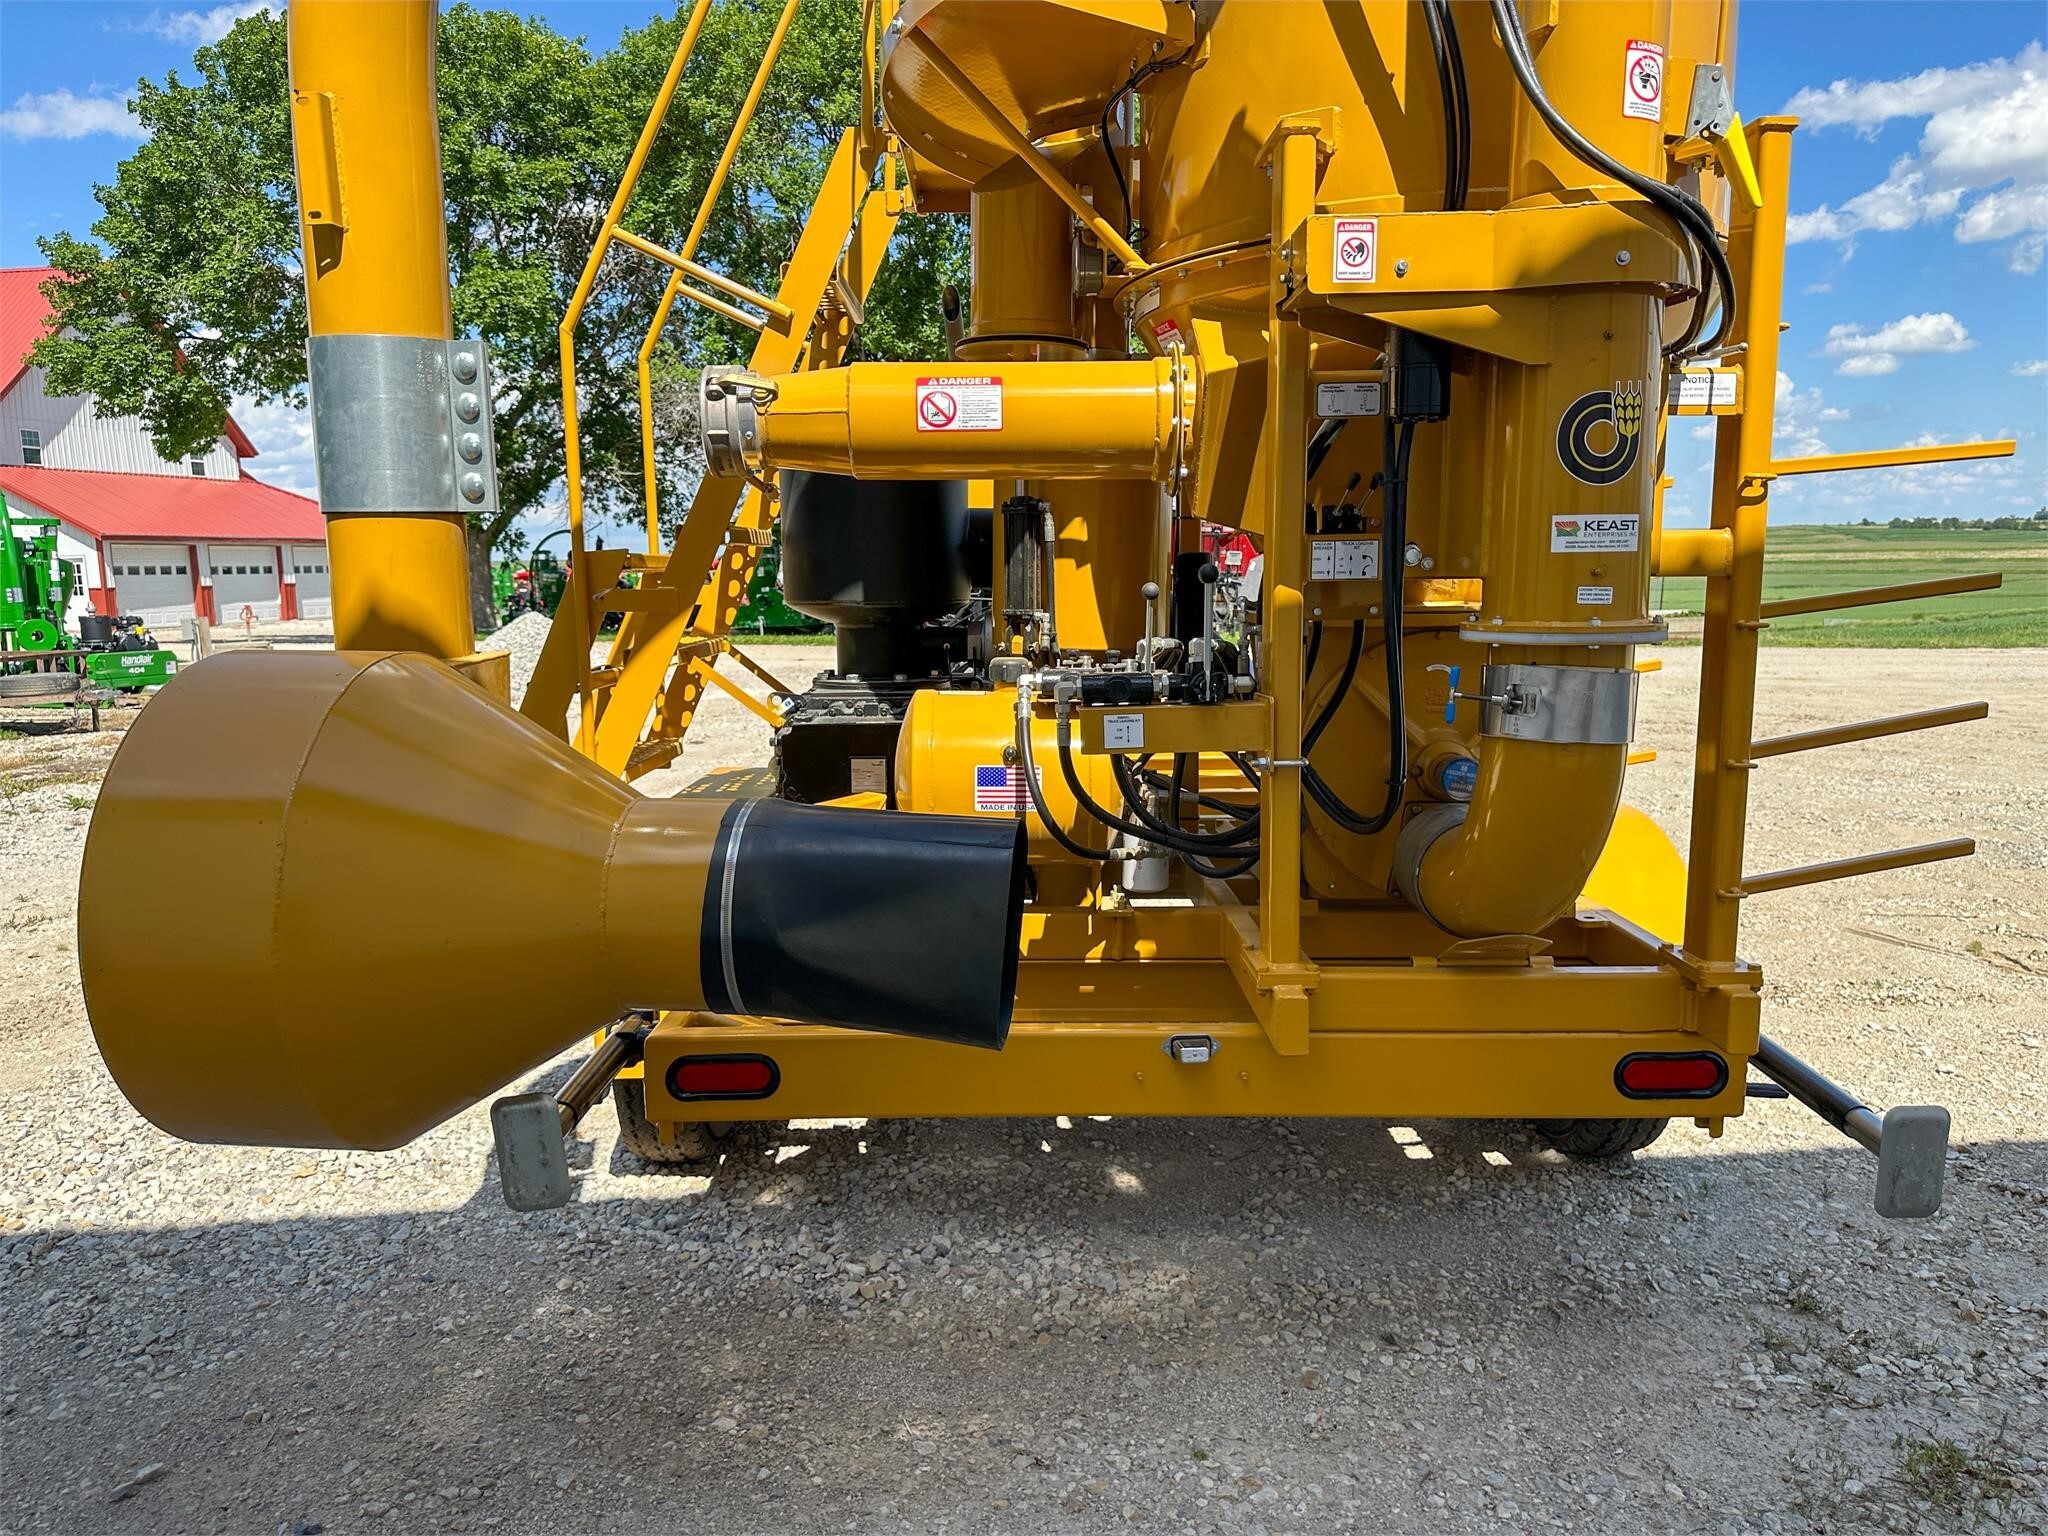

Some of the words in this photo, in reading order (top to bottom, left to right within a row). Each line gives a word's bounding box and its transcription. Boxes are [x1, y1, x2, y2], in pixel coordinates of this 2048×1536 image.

[938, 377, 992, 385] DANGER
[1686, 376, 1714, 384] NOTICE
[1583, 520, 1638, 532] KEAST
[121, 654, 154, 666] Handlair
